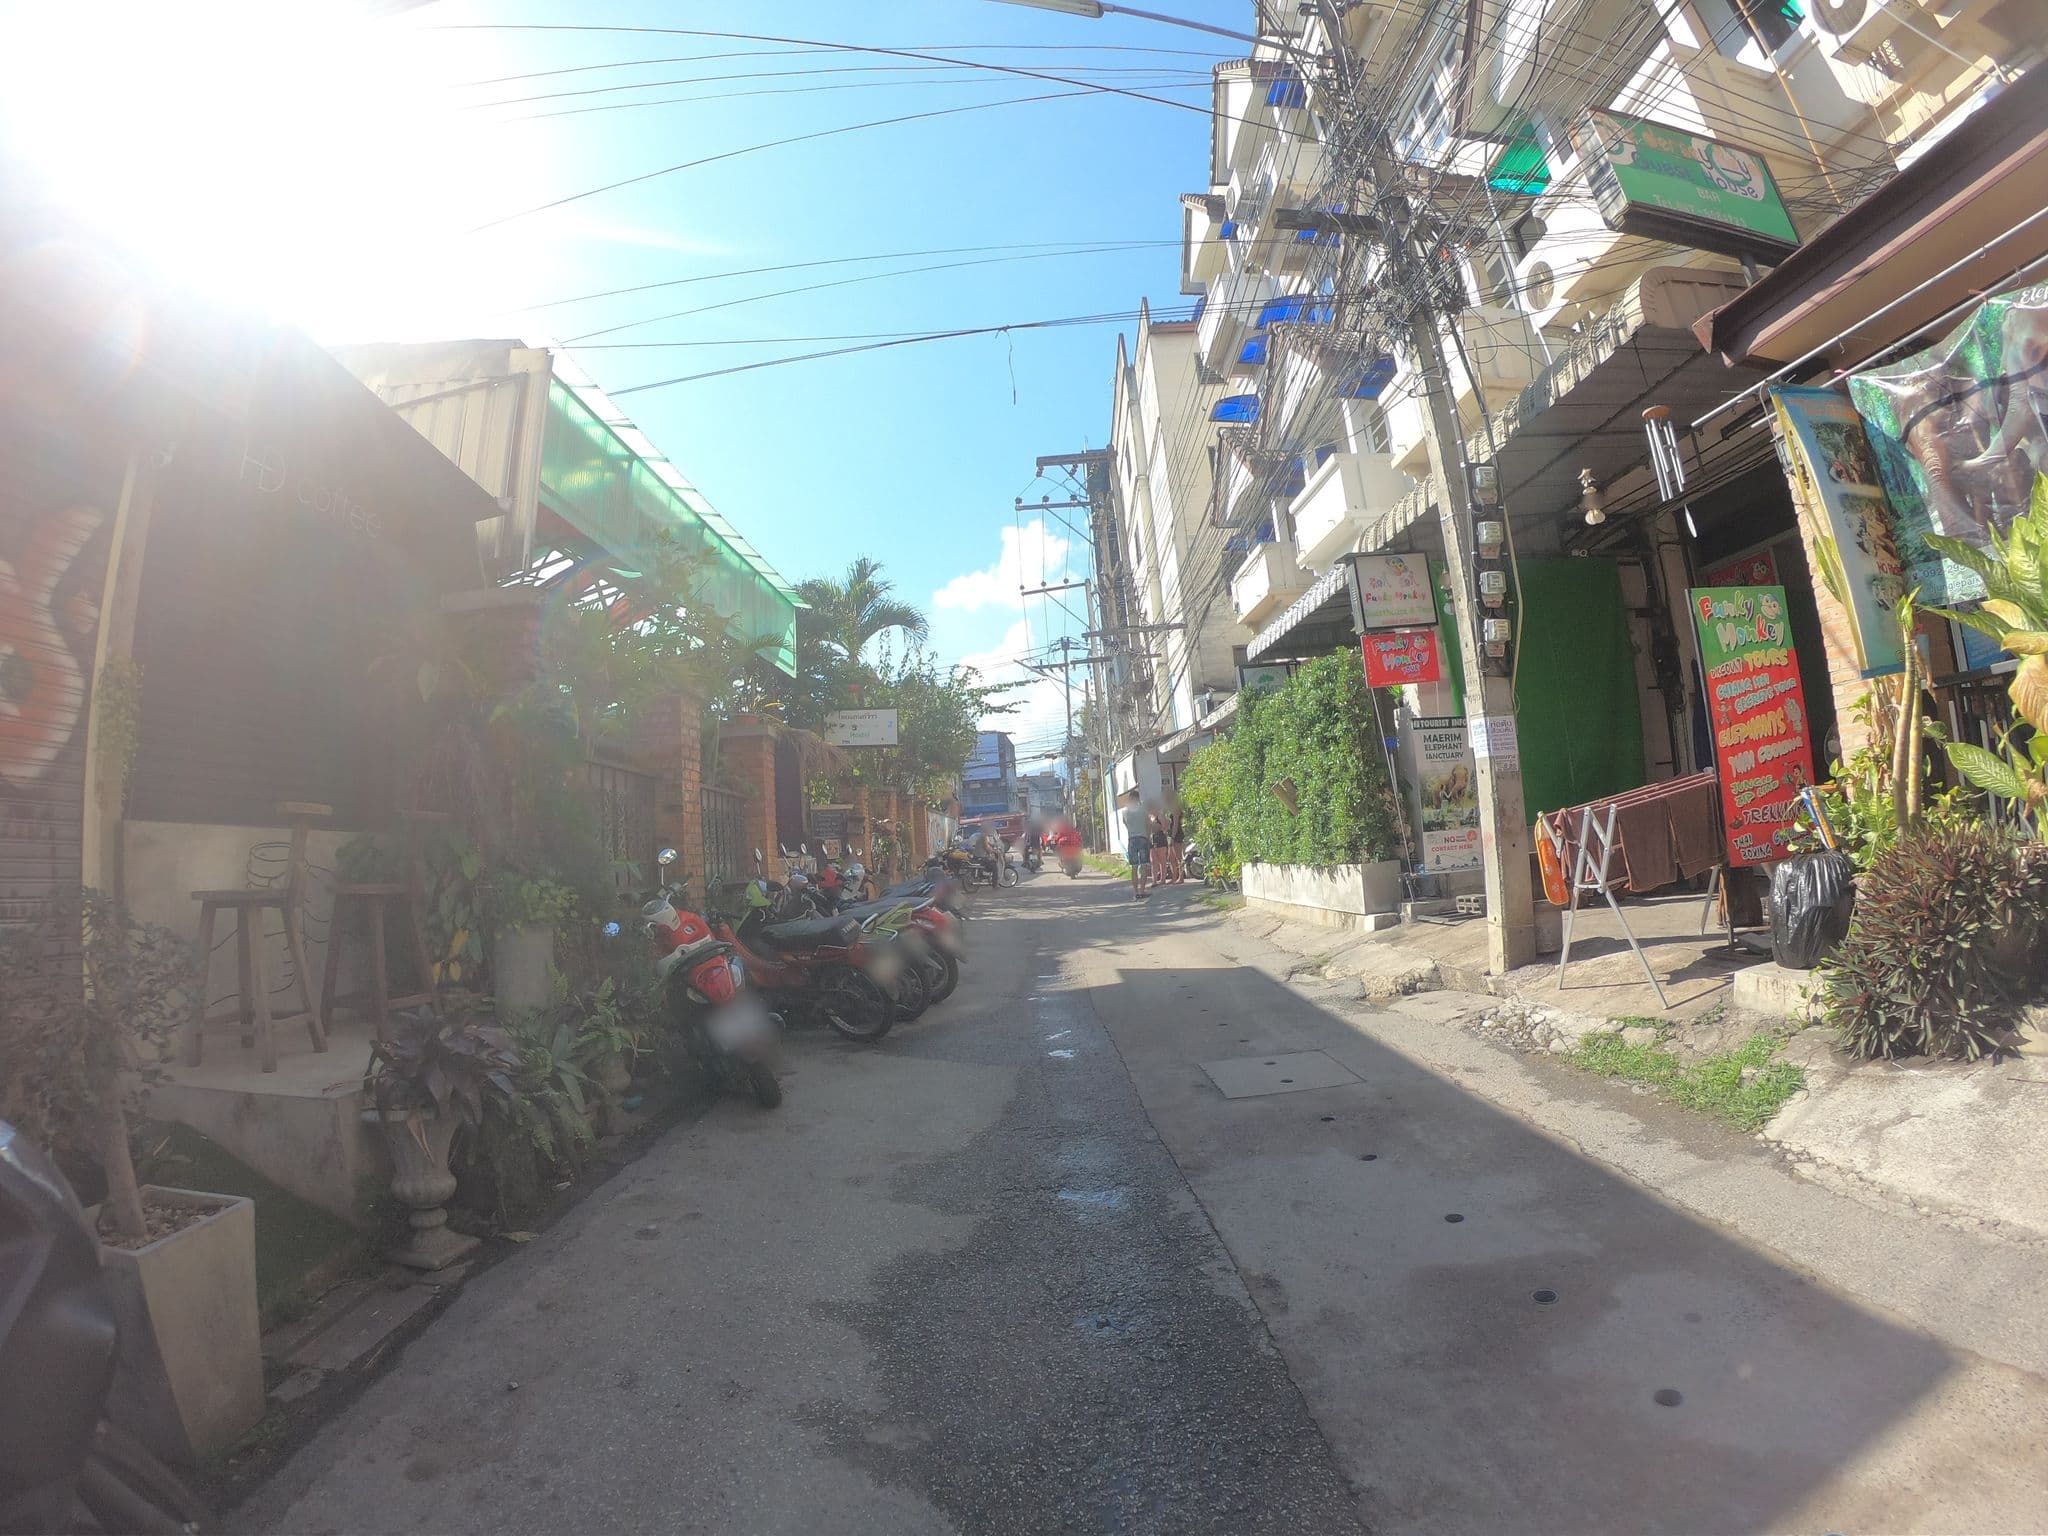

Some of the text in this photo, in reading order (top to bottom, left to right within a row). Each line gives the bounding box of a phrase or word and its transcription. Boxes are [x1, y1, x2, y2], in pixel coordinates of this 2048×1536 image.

[1698, 590, 1754, 626] Funky
[1716, 614, 1785, 653] Monkey
[1710, 648, 1788, 679] DISCOUNT TOURS
[1420, 718, 1449, 729] TOURIST
[1719, 707, 1787, 747] ELEPHANTS
[1423, 733, 1462, 743] MAERIM
[1424, 743, 1462, 752] ELEPHANT
[1741, 844, 1772, 860] BOXING
